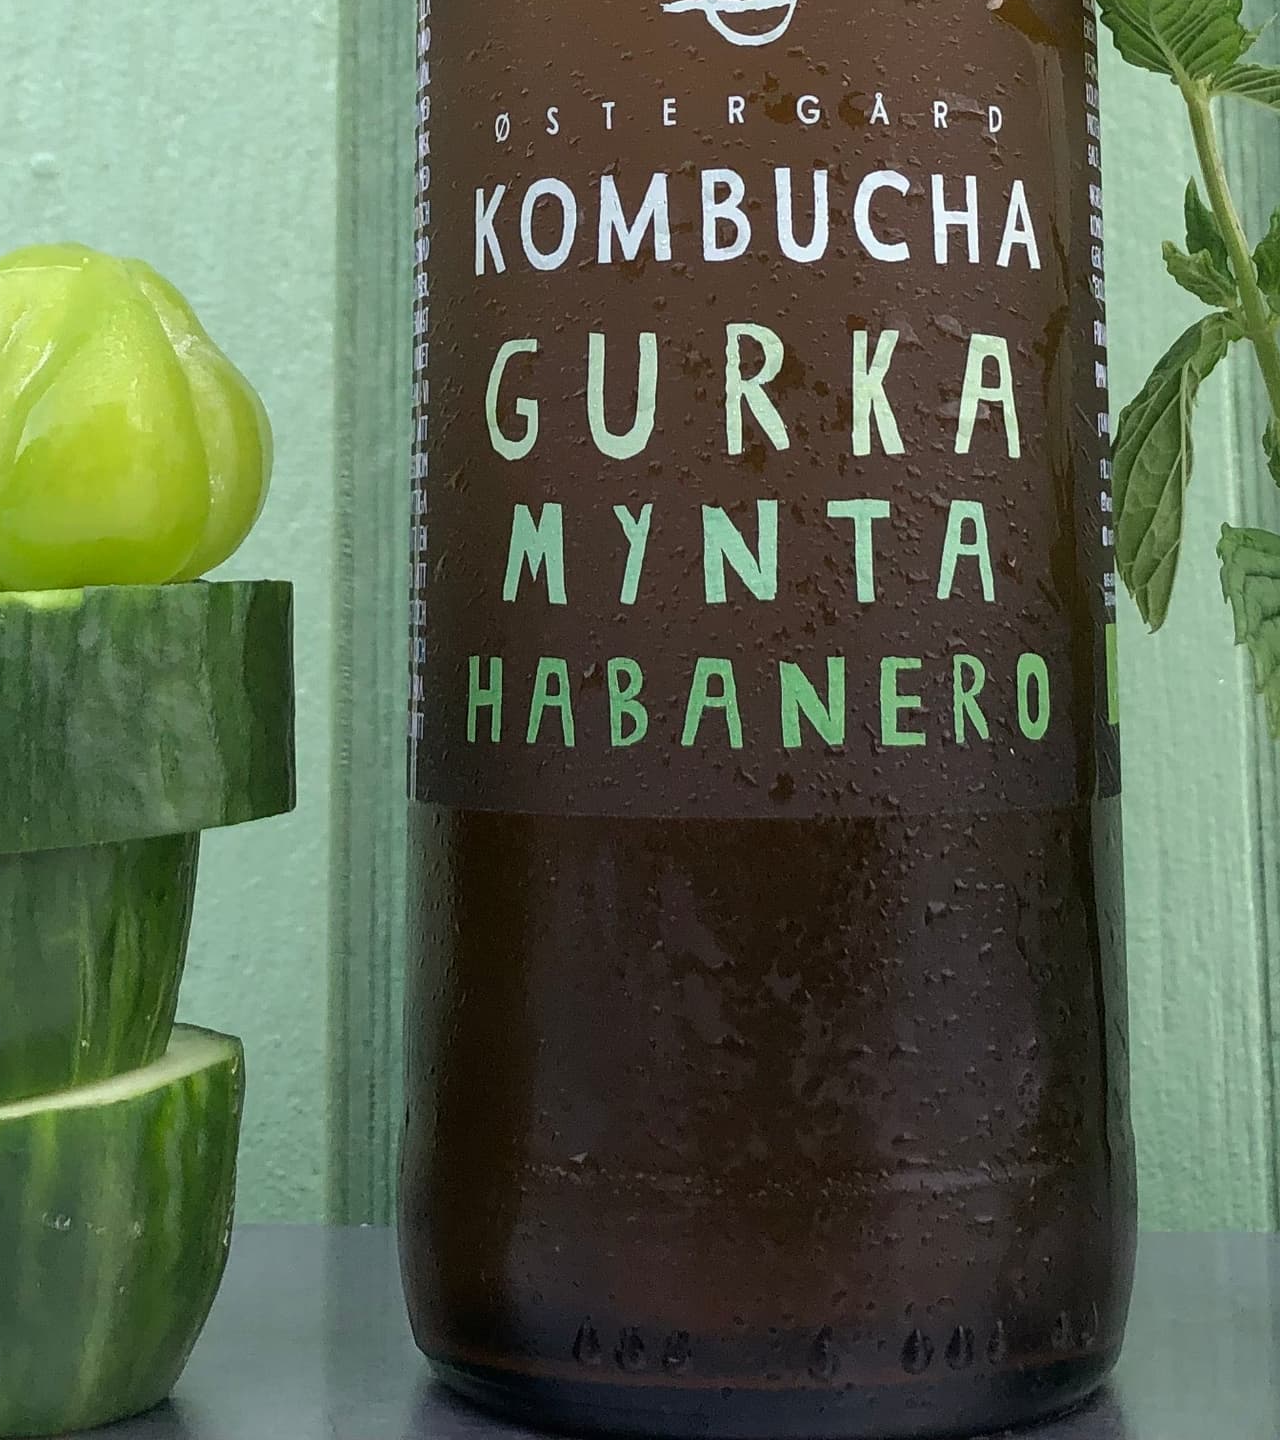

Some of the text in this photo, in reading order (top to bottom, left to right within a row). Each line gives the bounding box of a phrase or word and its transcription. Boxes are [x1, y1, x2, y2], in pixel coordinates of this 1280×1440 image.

[494, 92, 1004, 143] ØSTERGÅRD
[474, 167, 1042, 277] KOMBUCHA
[484, 323, 1022, 462] GURKA
[502, 497, 996, 606] MYNTA
[466, 652, 1052, 749] HABANERO
